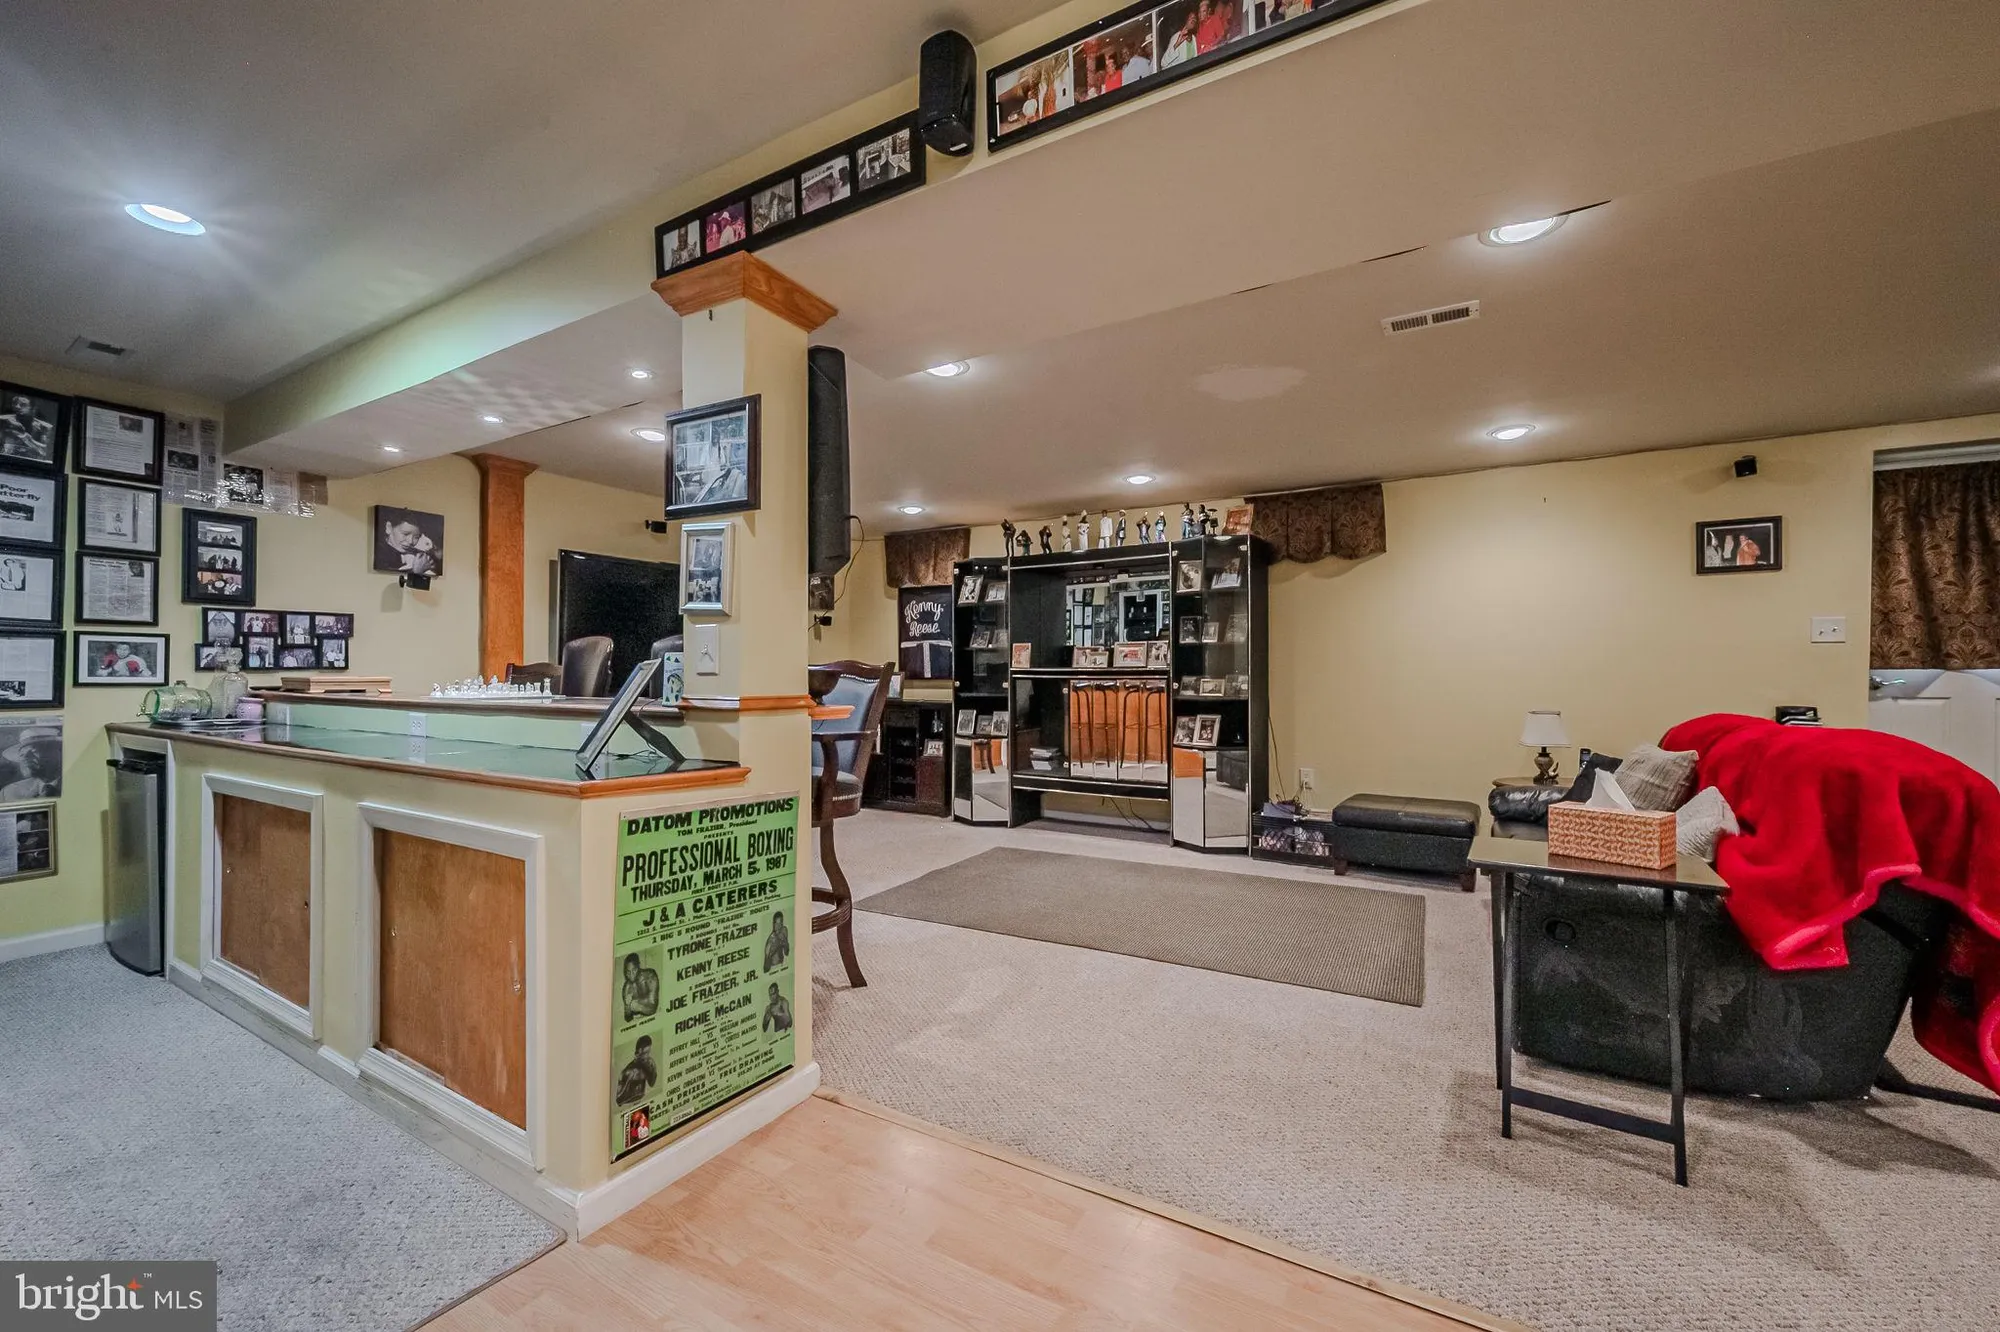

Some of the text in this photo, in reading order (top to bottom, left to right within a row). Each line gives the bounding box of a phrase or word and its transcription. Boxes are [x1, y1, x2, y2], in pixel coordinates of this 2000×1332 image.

[904, 600, 944, 624] Kenny
[909, 622, 940, 637] Reese
[627, 798, 793, 835] DATOM PROMOTIONS
[677, 828, 692, 836] TOM
[729, 817, 757, 827] President
[622, 826, 793, 886] PROFESSIONAL BOXING
[630, 854, 786, 903] THURSDAY, MARCH 5, 1987
[642, 909, 655, 927] J
[659, 905, 669, 923] &
[675, 901, 685, 918] A
[692, 879, 777, 914] CATERERS
[660, 931, 673, 941] BIG
[685, 921, 710, 933] ROUND
[667, 922, 757, 960] TYRONE FRAZIER
[677, 958, 712, 981] KENNY
[717, 946, 749, 967] REESE
[666, 994, 687, 1013] JOE
[744, 968, 758, 983] JR.
[675, 1009, 710, 1034] RICHIE
[715, 993, 751, 1018] McCAIN
[707, 1030, 713, 1039] VS
[713, 1040, 719, 1049] VS
[677, 1080, 705, 1100] PRIZES
[719, 1065, 736, 1079] FREE
[738, 1047, 772, 1070] DRAWING
